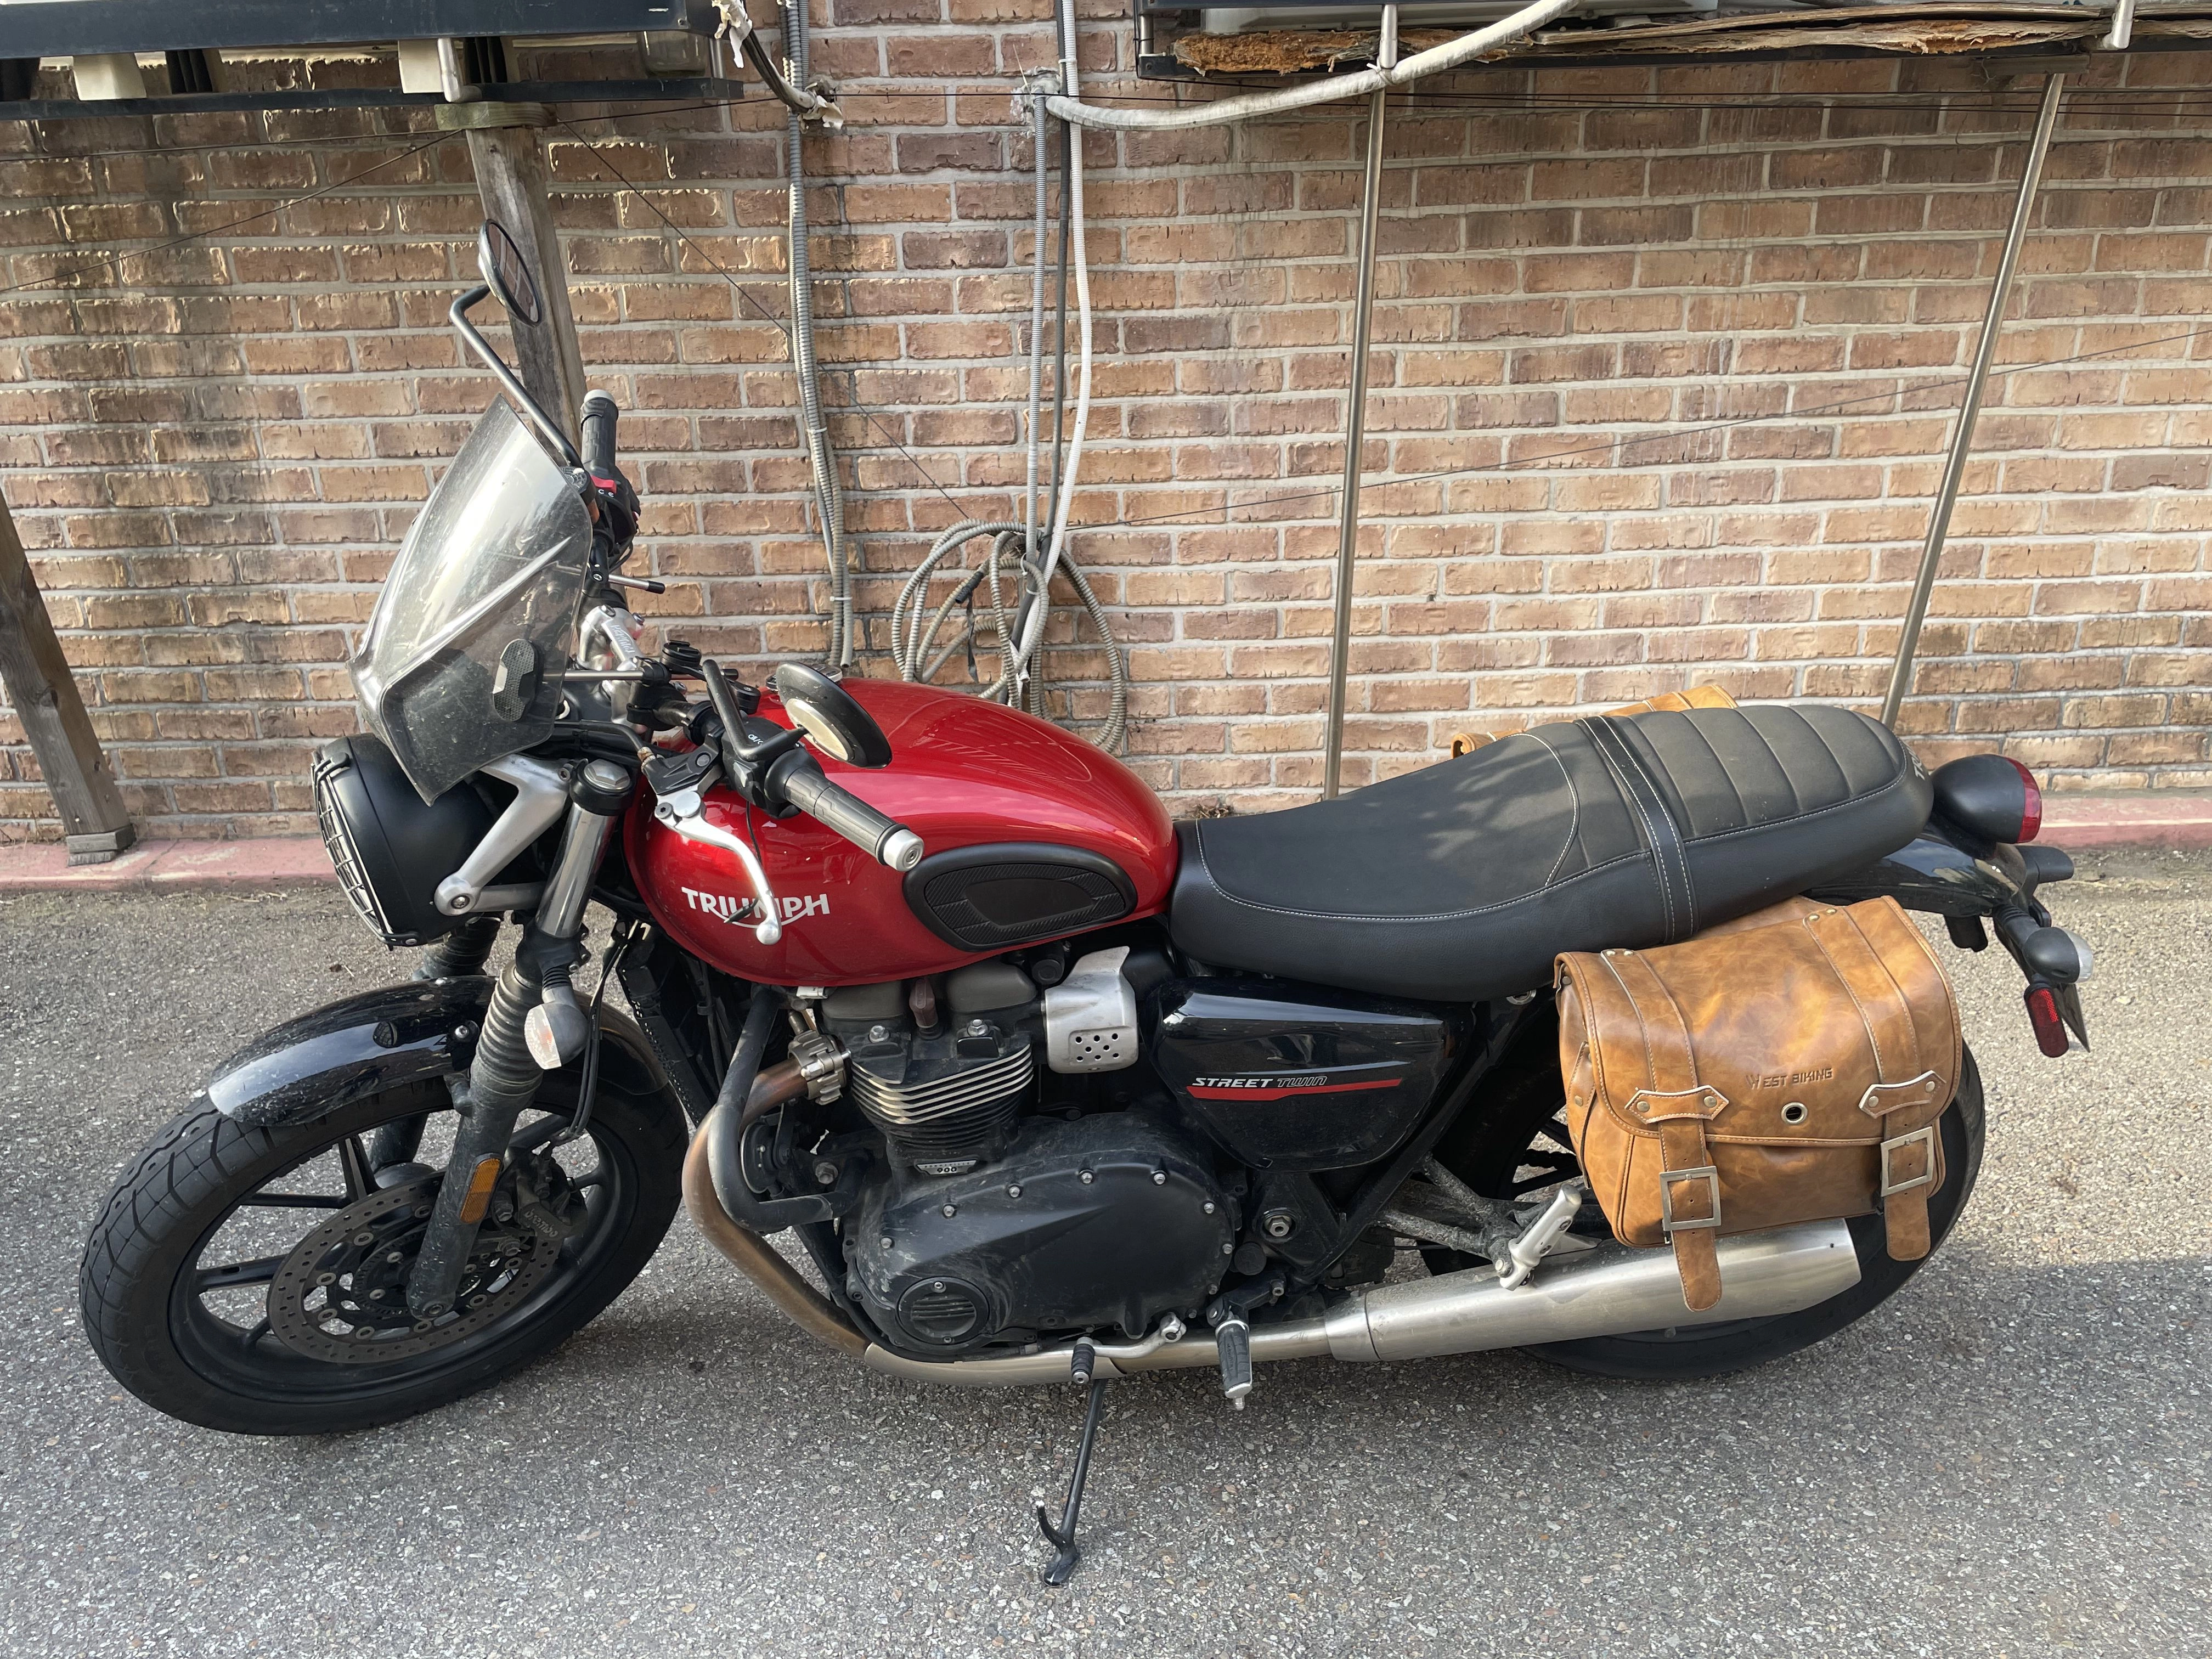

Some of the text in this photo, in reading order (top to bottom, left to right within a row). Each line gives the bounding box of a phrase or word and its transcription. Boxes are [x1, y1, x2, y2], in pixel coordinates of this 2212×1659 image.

[1192, 1076, 1328, 1088] STREET TWIN
[1746, 1068, 1833, 1090] WEST BIKING
[524, 1209, 558, 1237] brembo
